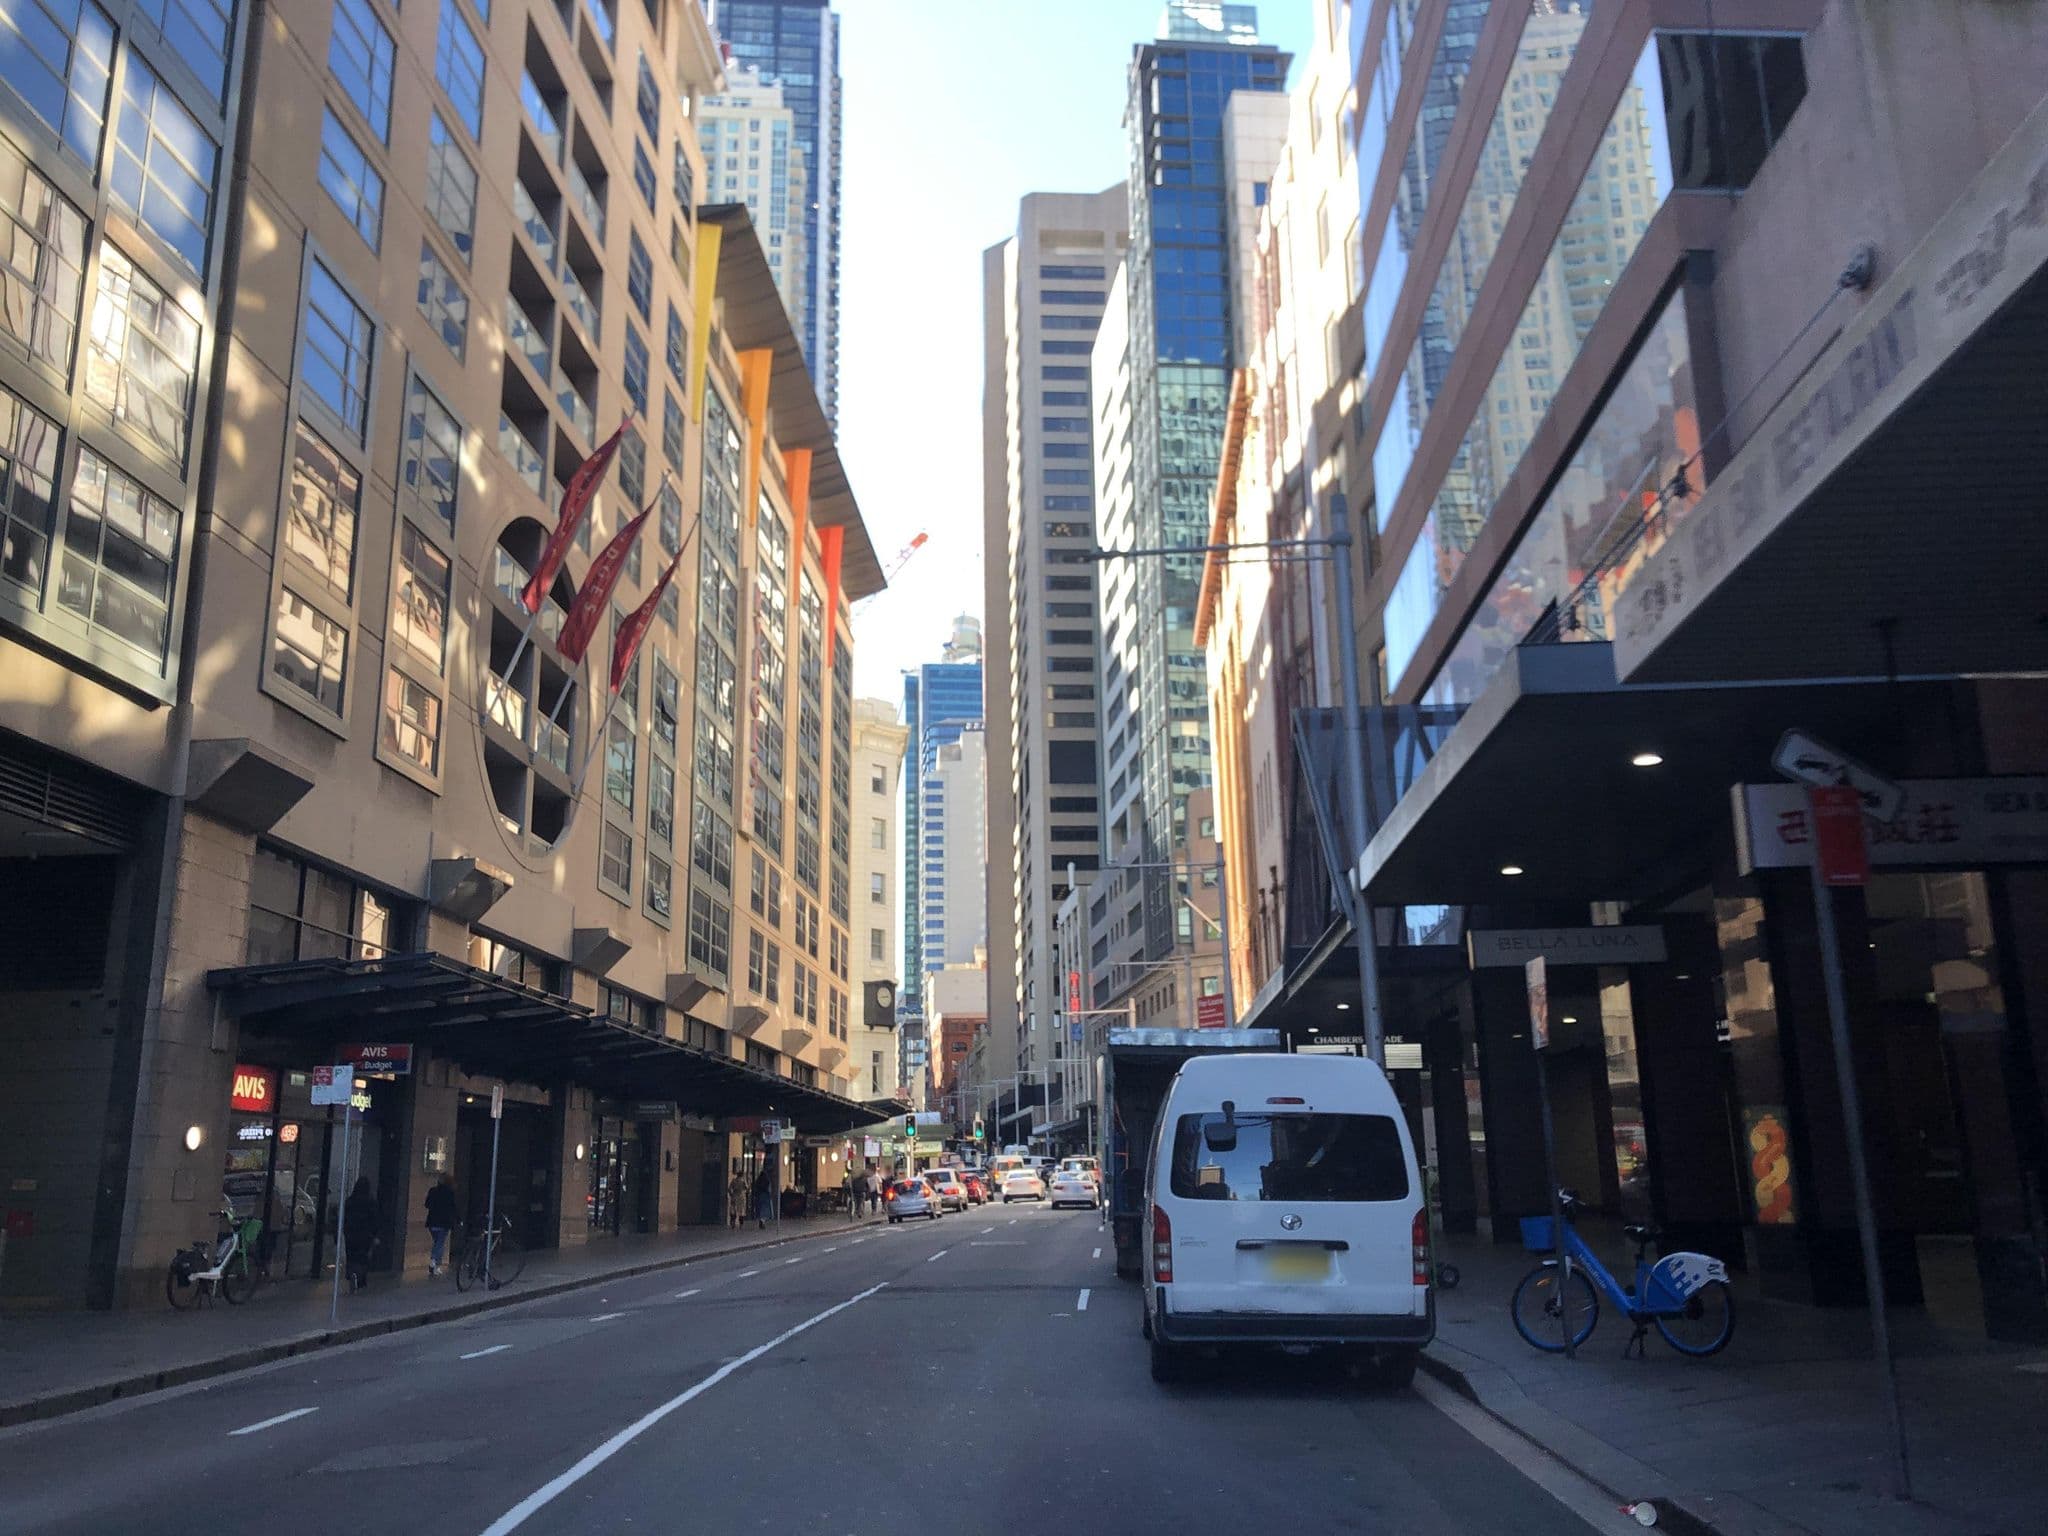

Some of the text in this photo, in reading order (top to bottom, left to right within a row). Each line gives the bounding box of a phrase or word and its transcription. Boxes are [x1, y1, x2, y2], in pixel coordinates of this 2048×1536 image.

[1498, 934, 1640, 950] BELLA LUNA
[1313, 1034, 1404, 1045] CHAMBERS ADE
[361, 1046, 388, 1058] AVIS
[364, 1060, 393, 1072] Budget
[232, 1074, 266, 1100] AVIS
[350, 1092, 372, 1113] udget
